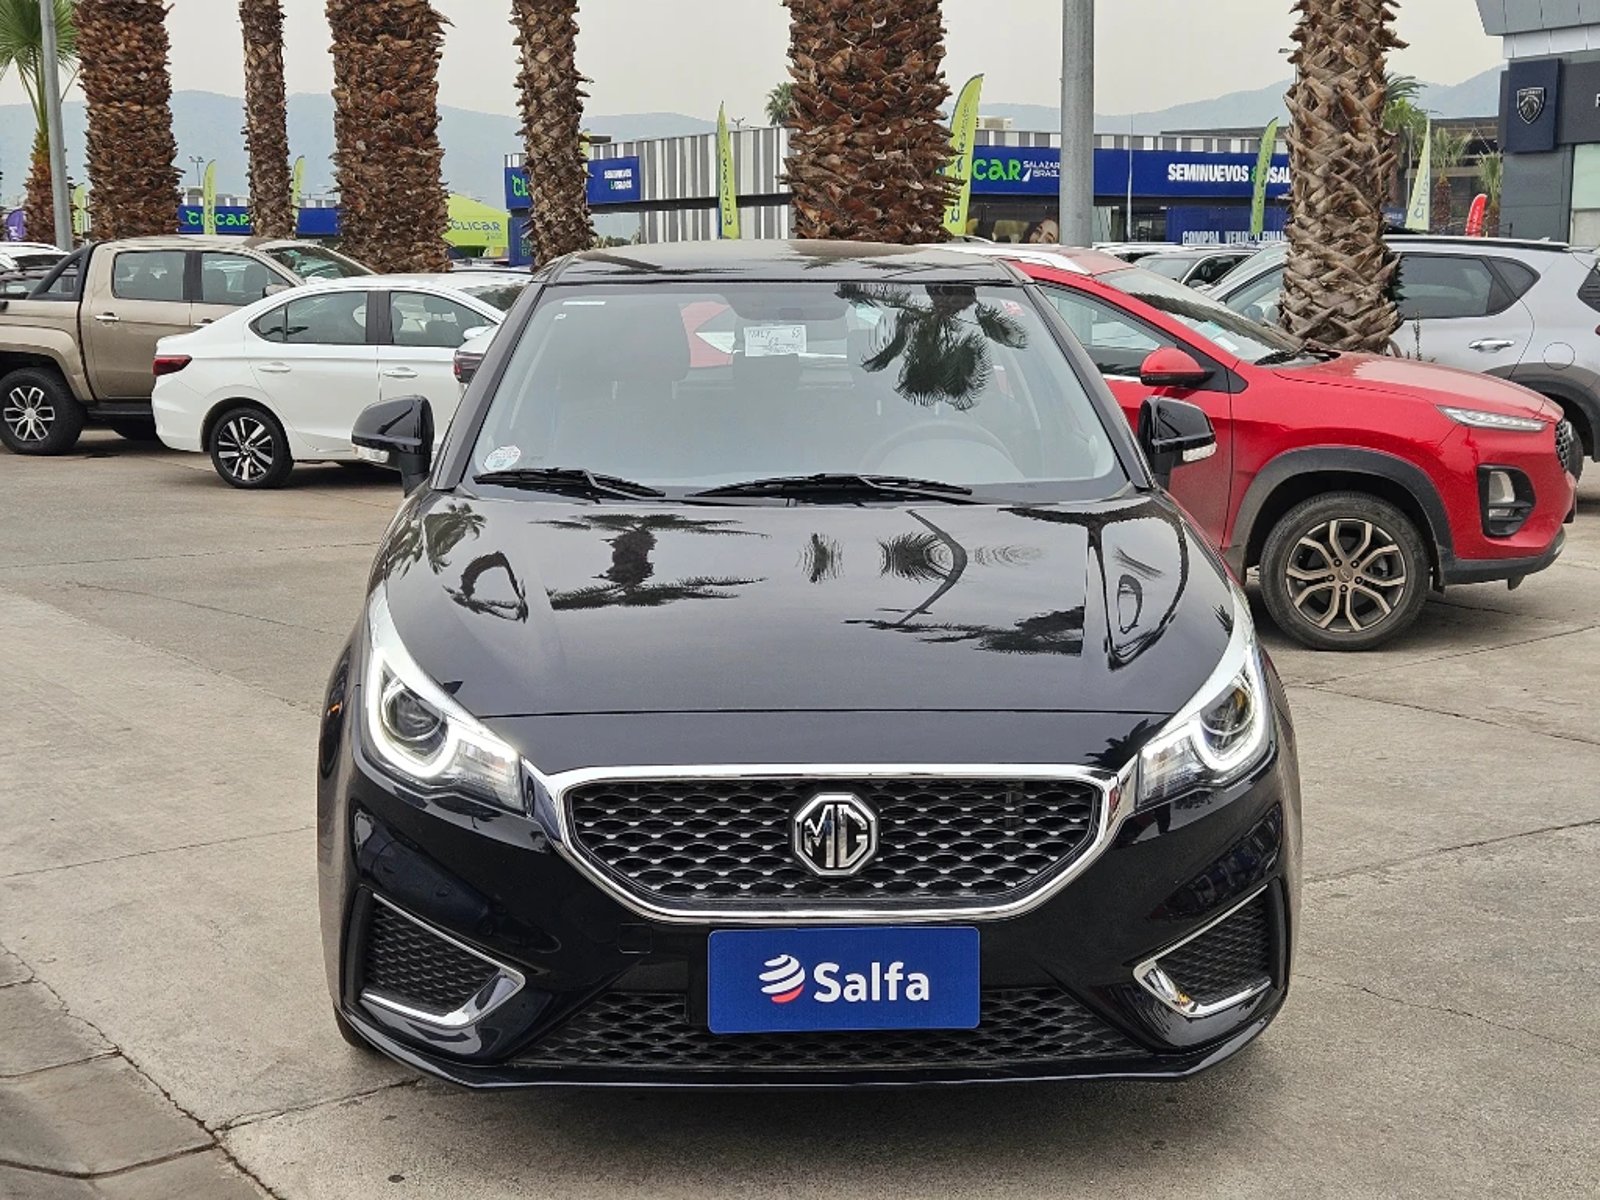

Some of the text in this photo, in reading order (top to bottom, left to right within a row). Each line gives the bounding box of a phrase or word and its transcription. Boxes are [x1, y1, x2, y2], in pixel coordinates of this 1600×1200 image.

[972, 158, 1021, 181] CaR
[1167, 163, 1249, 182] SEMINUEVOS
[185, 210, 249, 226] CCaR
[803, 804, 868, 868] MG
[813, 961, 929, 1002] Salfa
